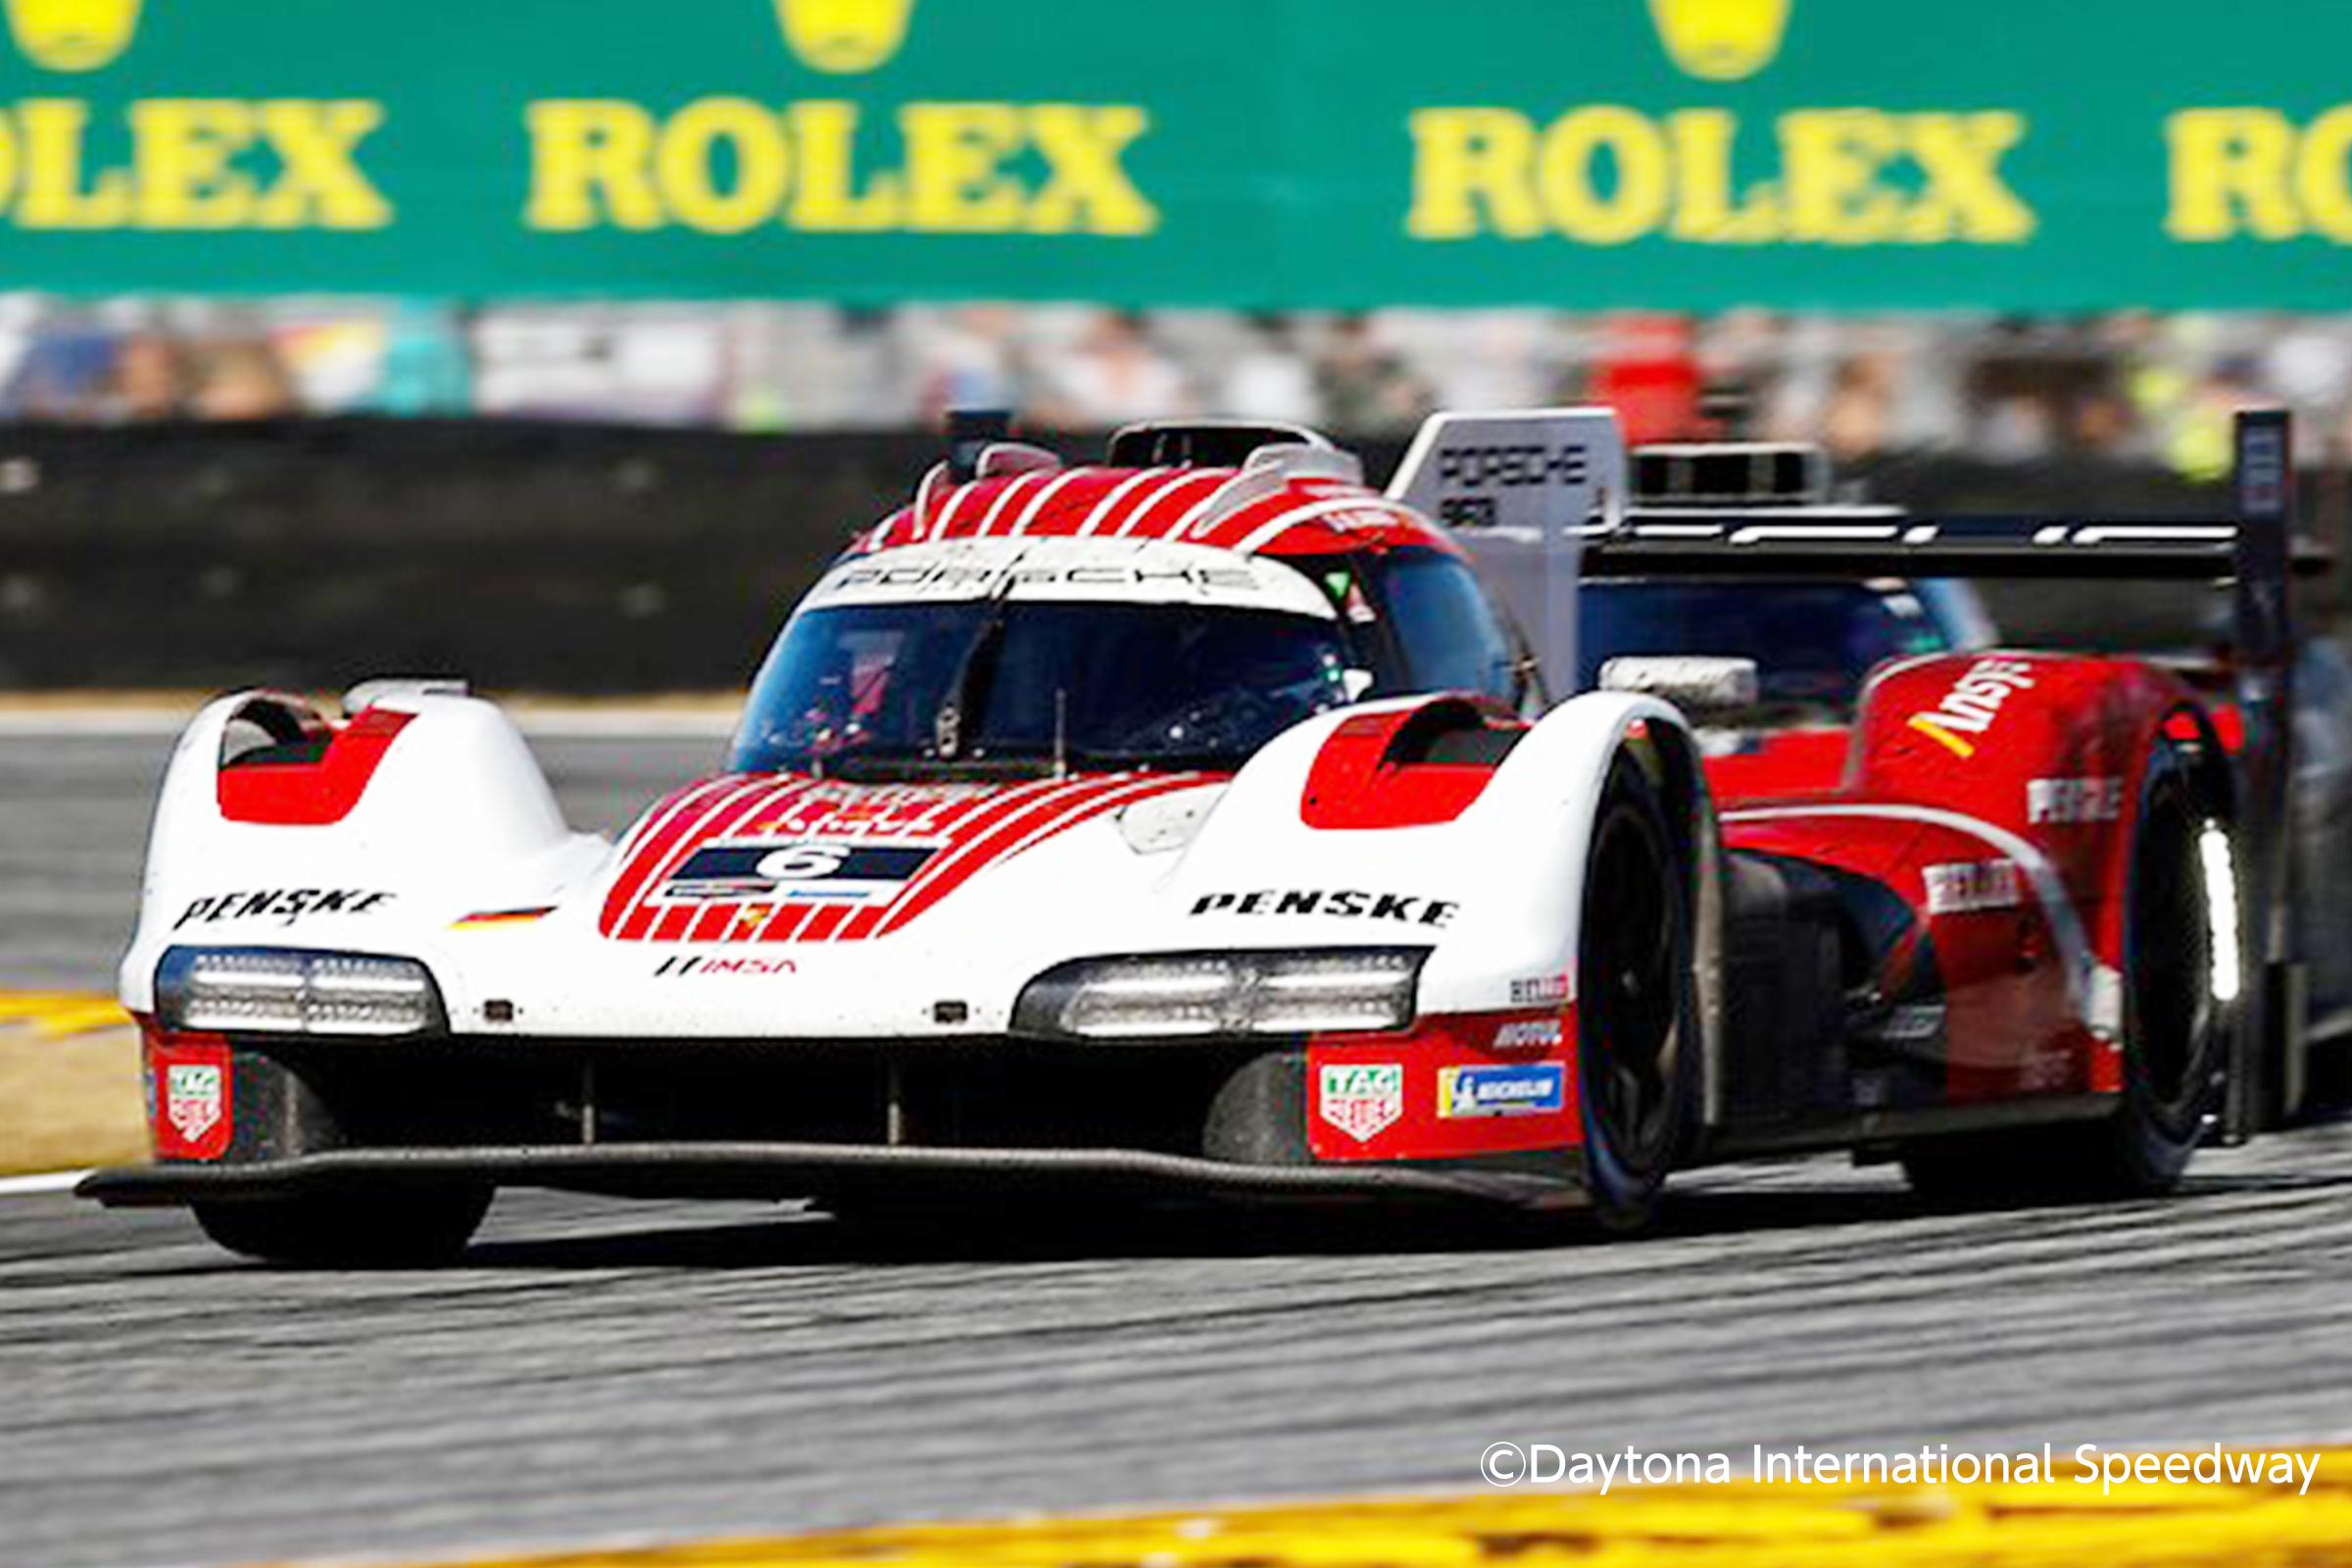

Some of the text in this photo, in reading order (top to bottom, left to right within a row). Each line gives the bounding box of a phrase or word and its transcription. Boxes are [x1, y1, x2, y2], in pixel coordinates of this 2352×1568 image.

[0, 98, 390, 229] LEX
[526, 98, 1156, 234] ROLEX
[1407, 106, 2034, 244] ROLEX
[1441, 446, 1587, 485] PORSCHE
[756, 846, 851, 880] 6
[173, 889, 397, 930] PENSKE
[1190, 890, 1459, 927] PENSKE
[1326, 1069, 1396, 1095] TAG
